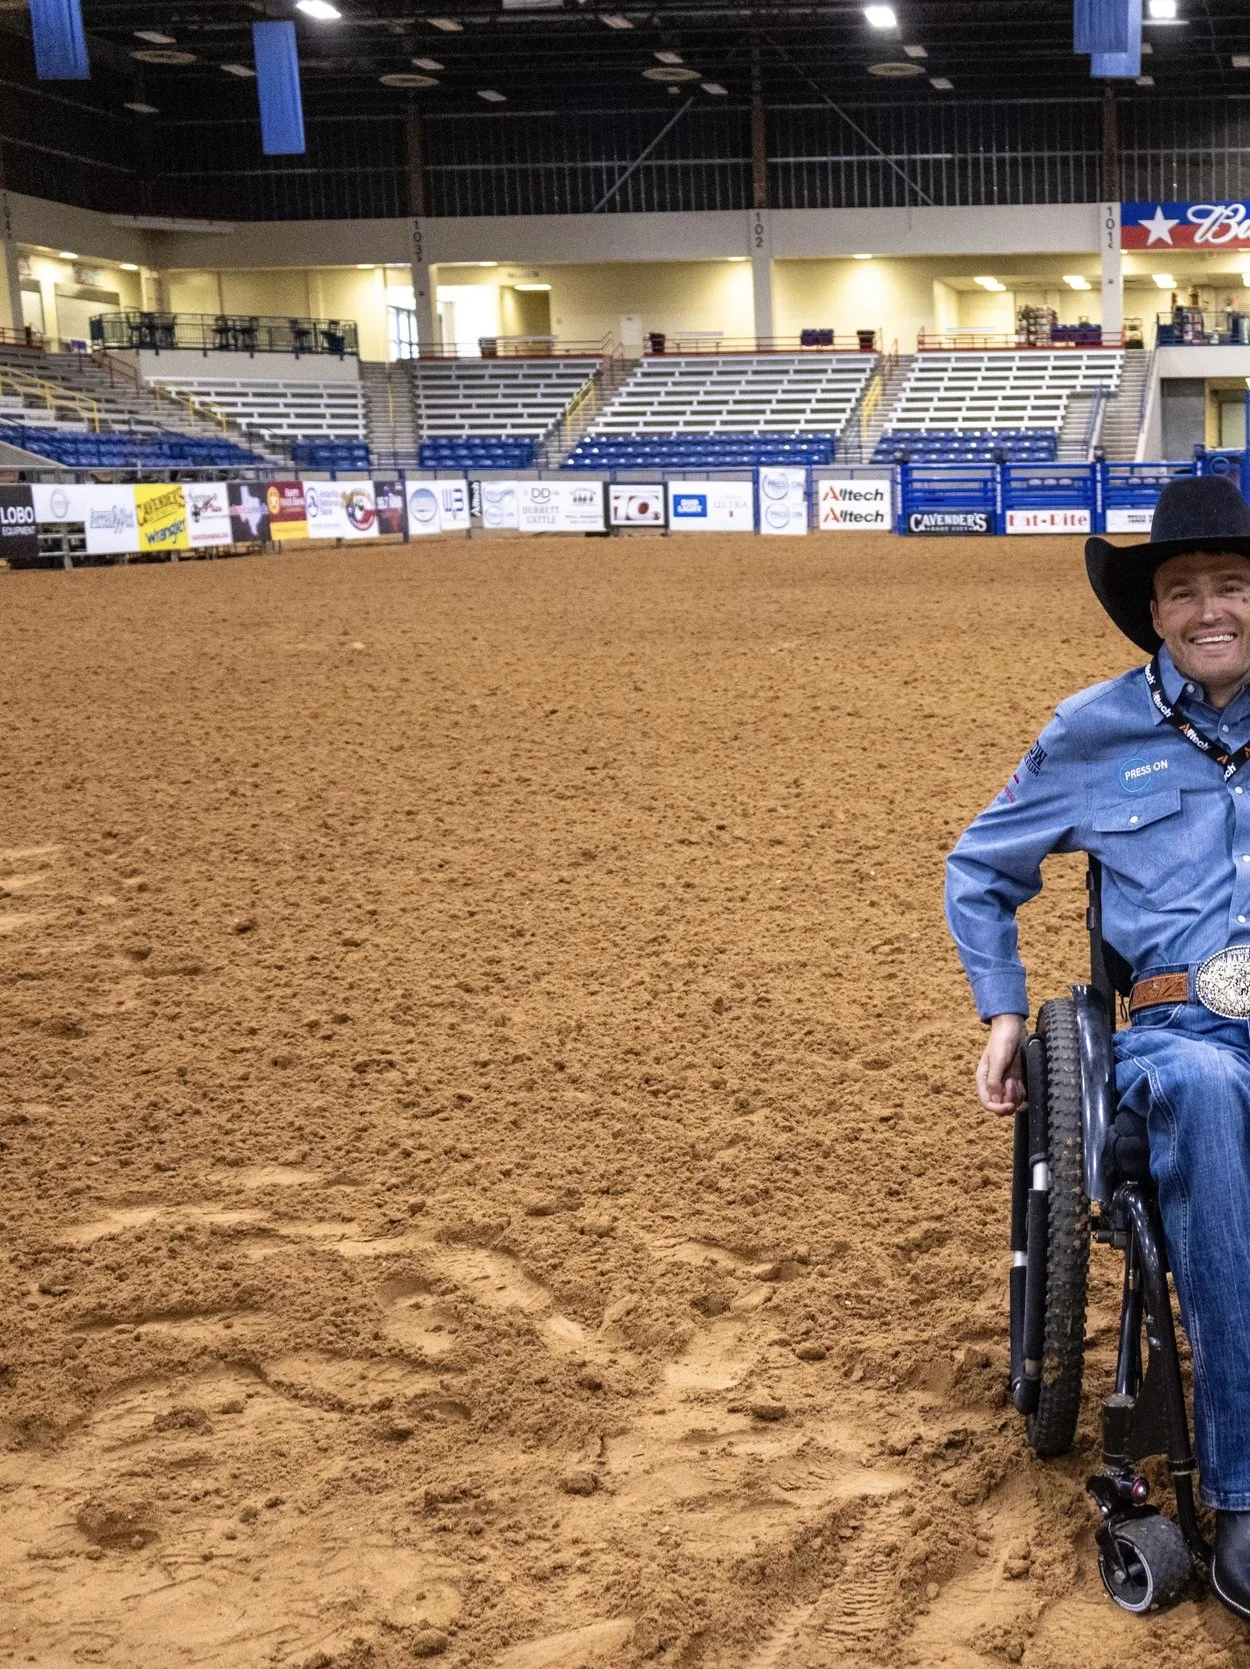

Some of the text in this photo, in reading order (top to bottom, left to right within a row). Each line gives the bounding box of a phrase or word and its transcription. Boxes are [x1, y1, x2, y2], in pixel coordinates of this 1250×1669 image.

[755, 212, 763, 248] 102
[1106, 206, 1115, 241] 101
[823, 485, 884, 501] Alltech
[0, 506, 34, 523] LOBO
[823, 507, 884, 523] Alltech
[909, 513, 988, 532] CAVENDER'S
[1180, 723, 1209, 751] Alltech
[1125, 759, 1168, 781] PRESS ON
